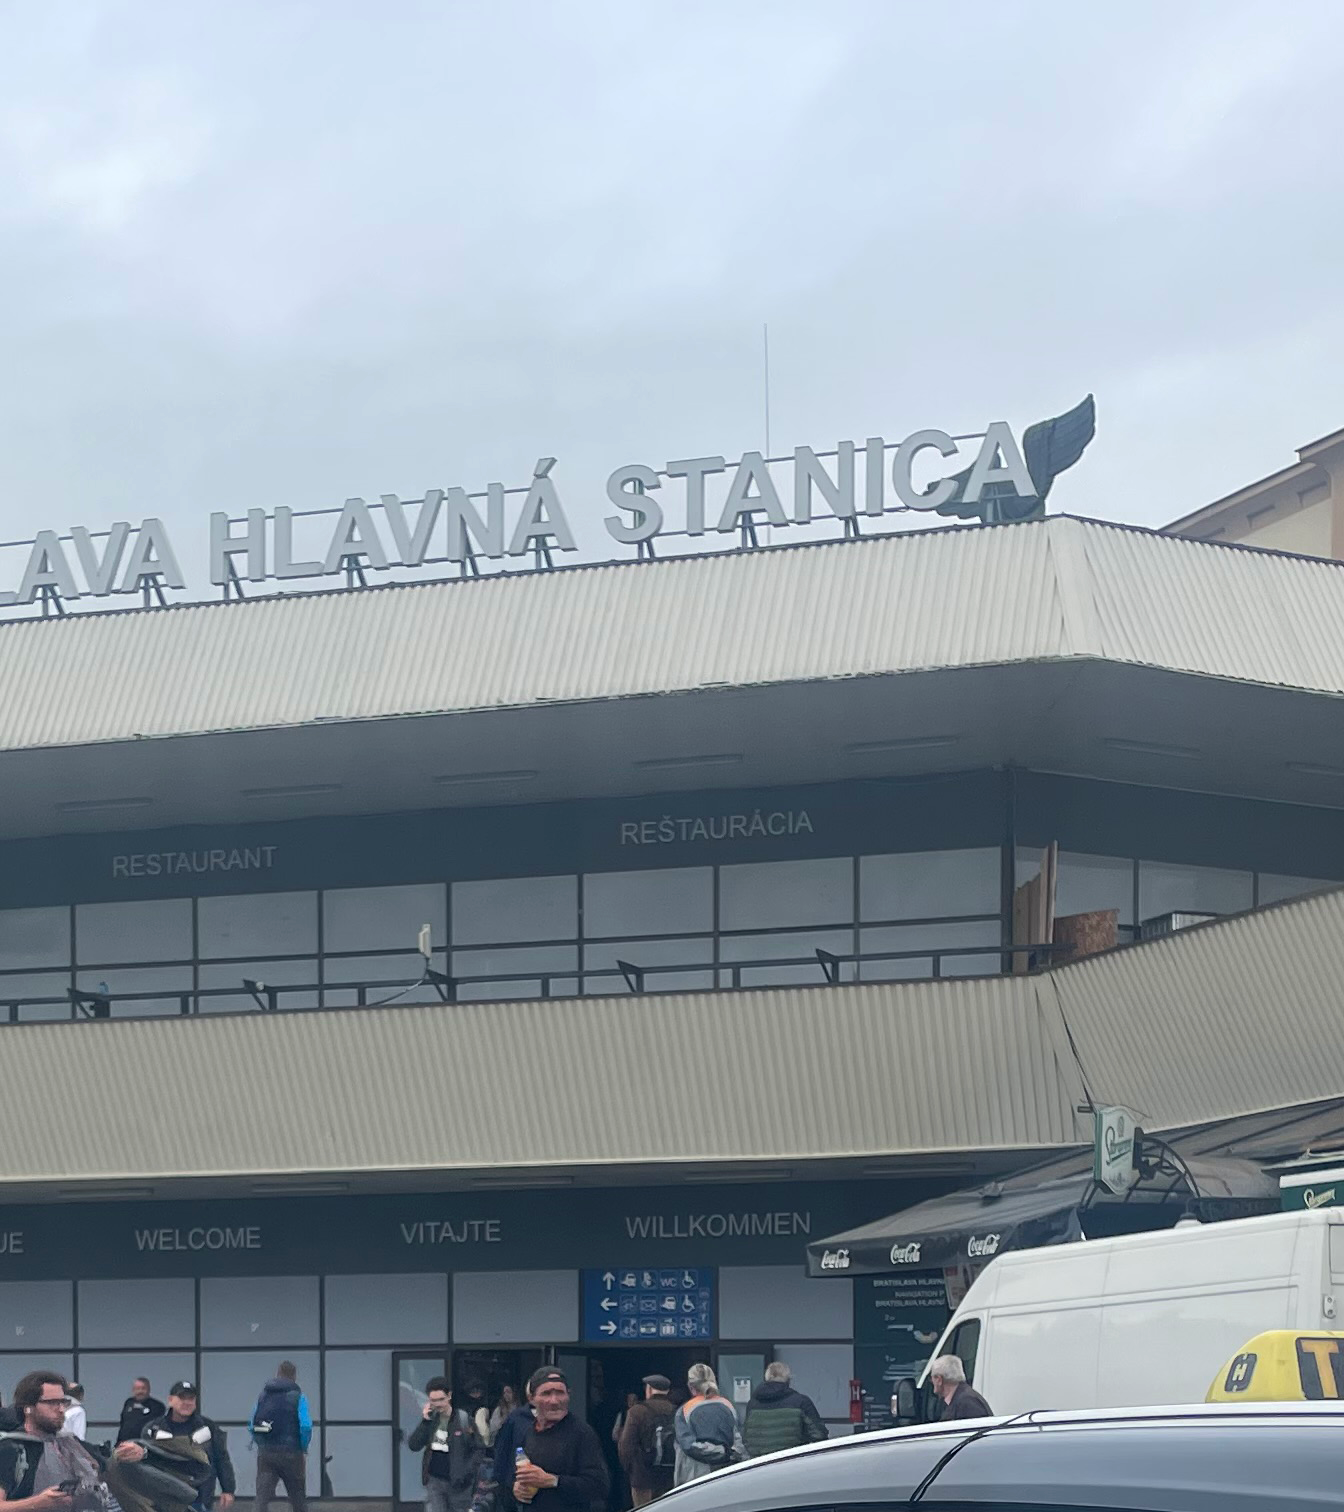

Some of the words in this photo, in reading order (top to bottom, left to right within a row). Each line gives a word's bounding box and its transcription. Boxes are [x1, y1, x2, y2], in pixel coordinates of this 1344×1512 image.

[209, 457, 578, 586] HLAVNÁ
[604, 422, 1037, 544] STANICA
[620, 808, 815, 846] REŠTAURÁCIA
[112, 845, 279, 879] RESTAURANT
[134, 1226, 262, 1251] WELCOME
[400, 1219, 502, 1245] VITAJTE
[625, 1211, 812, 1239] WILLKOMMEN
[660, 1277, 677, 1288] WC
